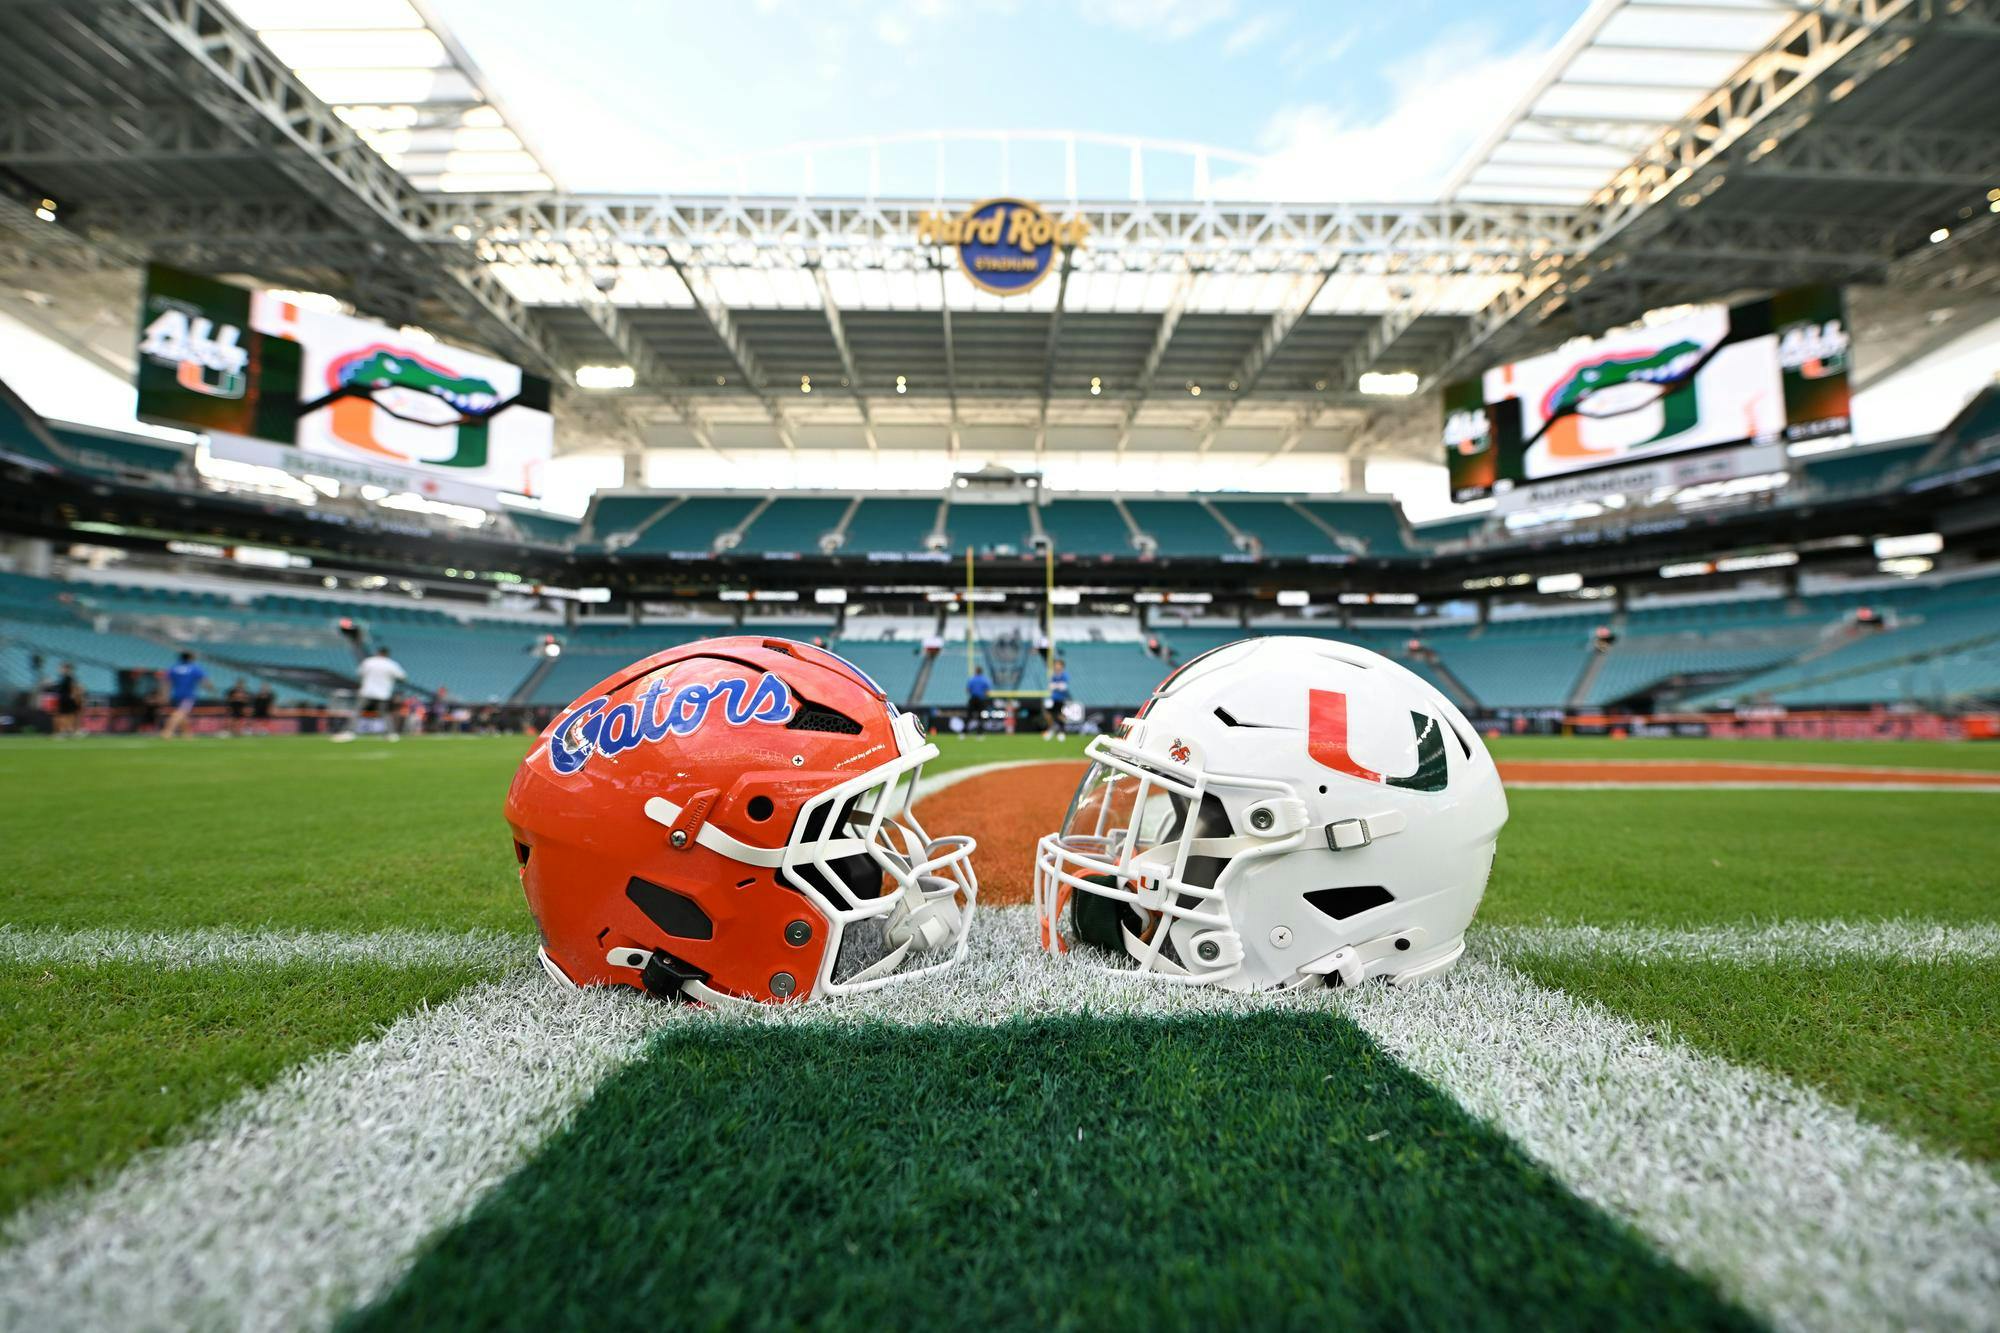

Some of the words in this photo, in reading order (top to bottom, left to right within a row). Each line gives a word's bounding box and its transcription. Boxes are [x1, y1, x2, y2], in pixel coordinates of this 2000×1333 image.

[918, 207, 1005, 246] Hard
[1006, 208, 1091, 253] Rock
[973, 256, 1038, 272] STADIUM
[550, 672, 796, 776] Gators
[1308, 688, 1449, 792] U
[1140, 875, 1160, 891] U
